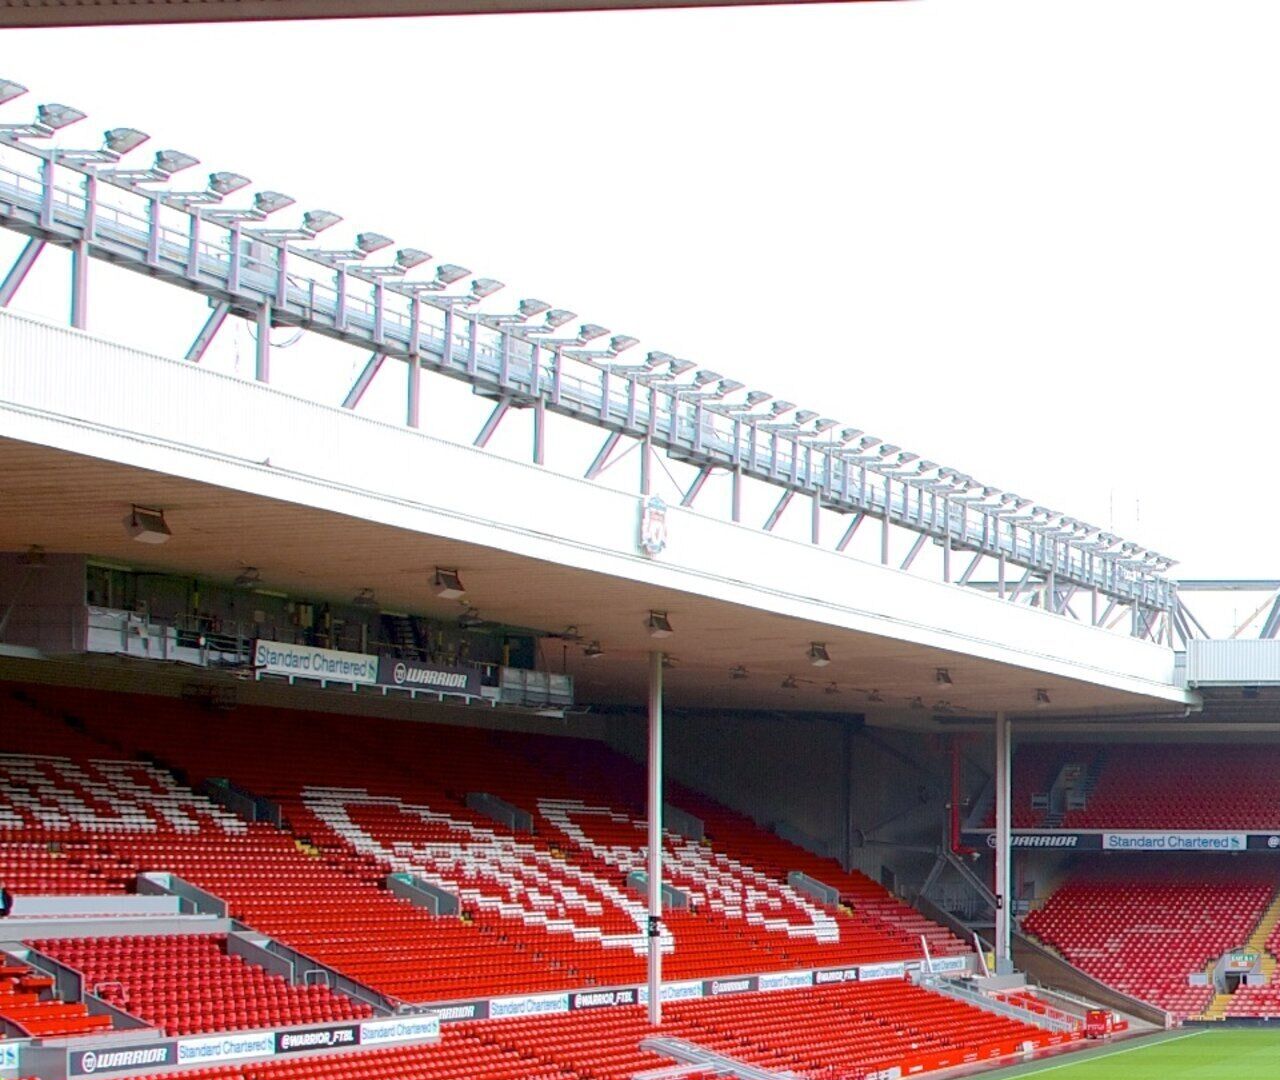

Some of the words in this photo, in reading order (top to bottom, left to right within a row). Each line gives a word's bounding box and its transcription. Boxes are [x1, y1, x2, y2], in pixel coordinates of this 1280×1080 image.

[258, 646, 310, 670] Standard
[313, 654, 367, 677] Chartered
[407, 669, 467, 688] WARRIOR
[1109, 835, 1164, 848] Standard
[1168, 836, 1229, 849] Chartered
[180, 1043, 221, 1059] Standard
[223, 1038, 266, 1055] Chartered
[281, 1030, 354, 1049] @WARRIOR_FTBL
[97, 1048, 167, 1068] WARRIOR
